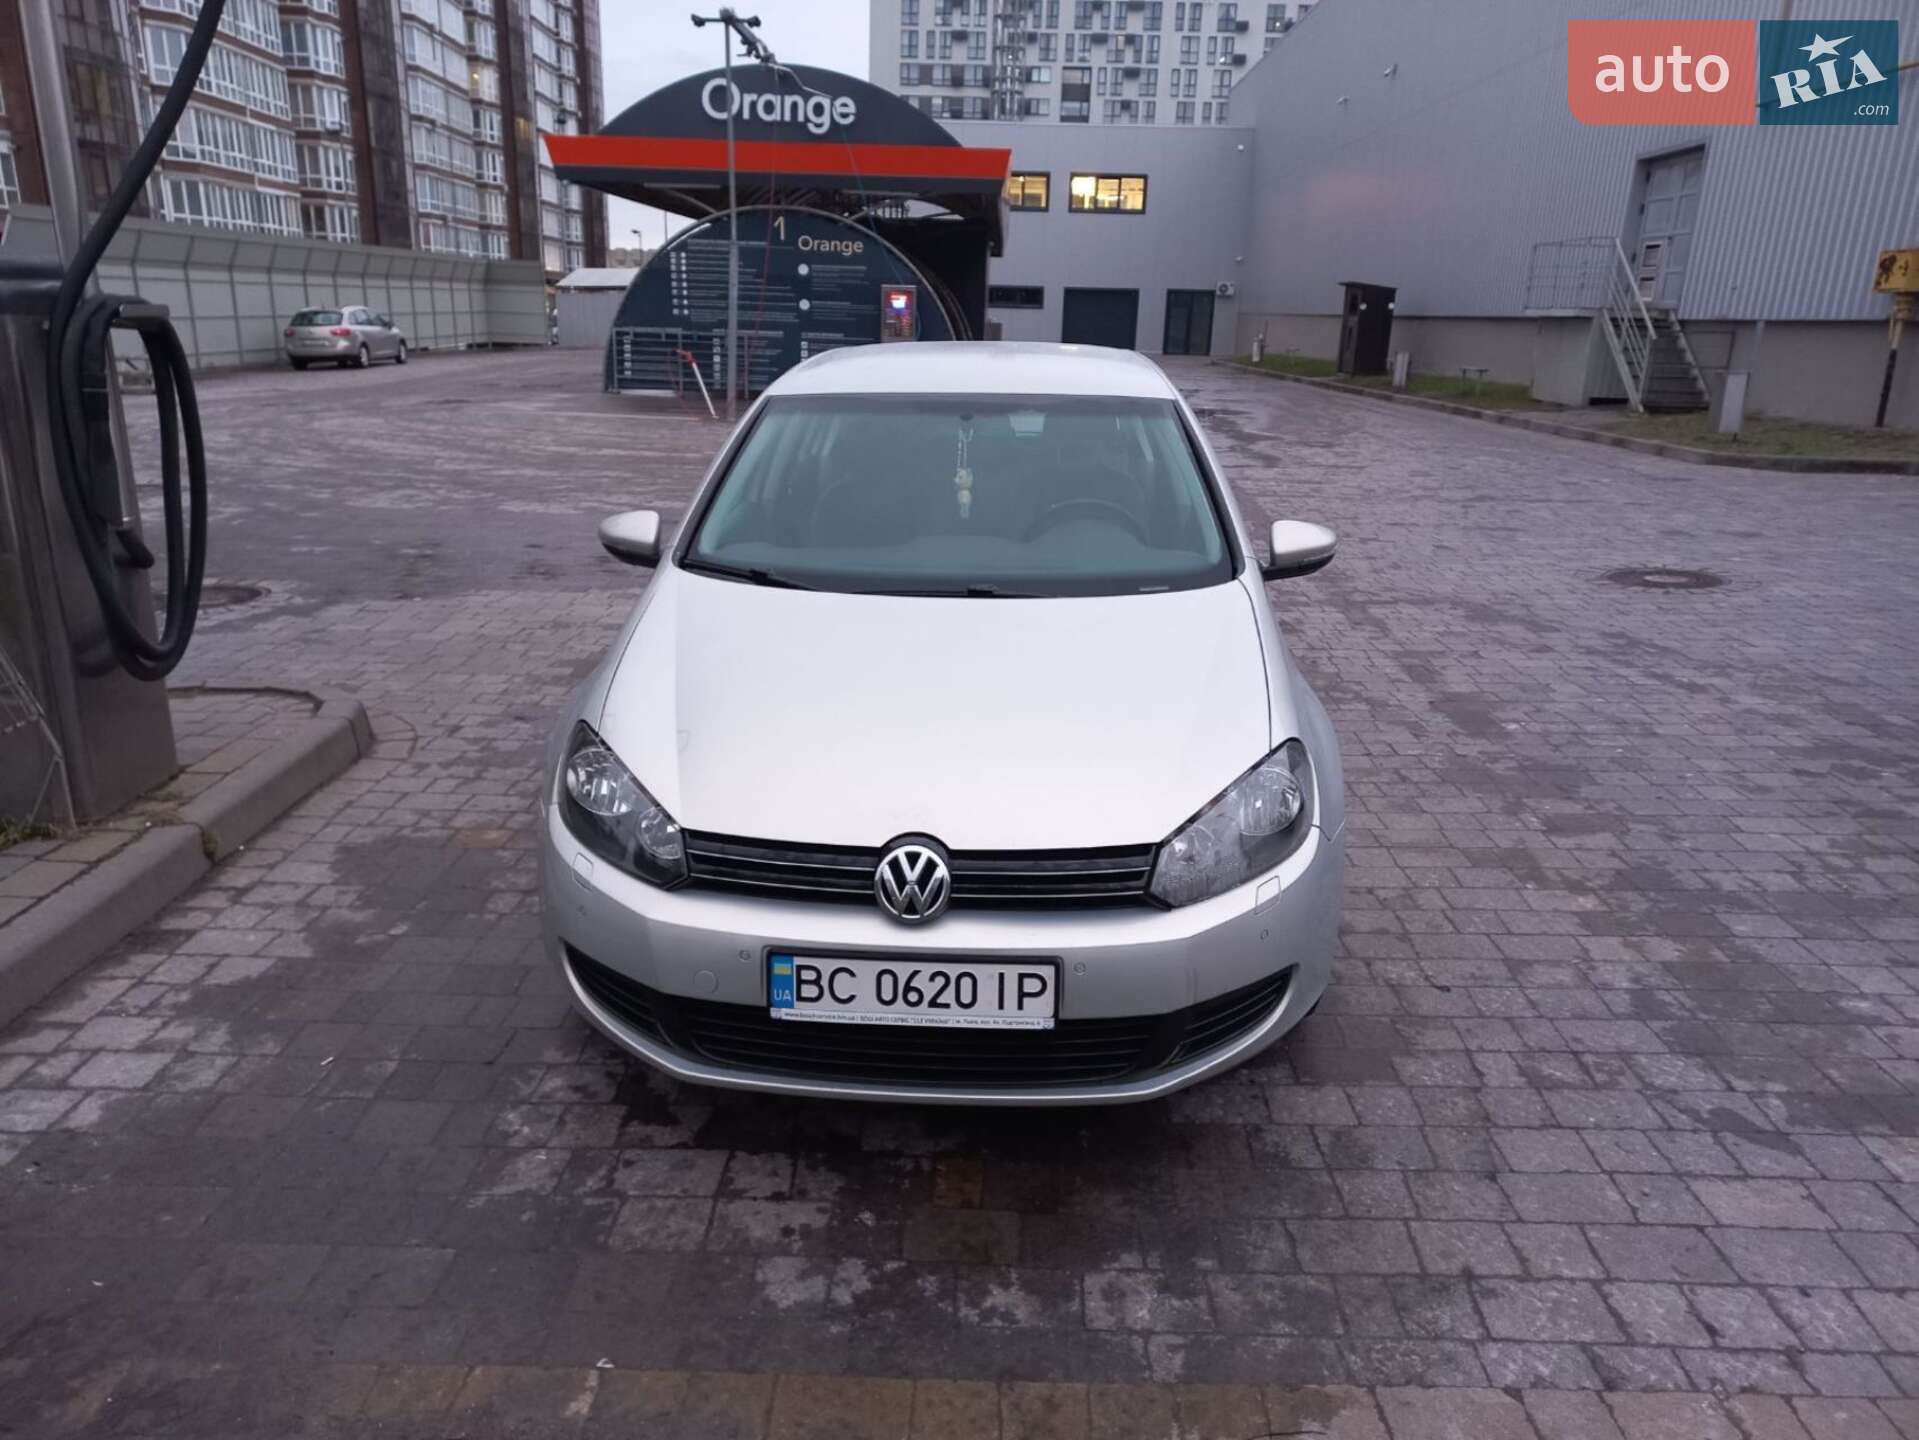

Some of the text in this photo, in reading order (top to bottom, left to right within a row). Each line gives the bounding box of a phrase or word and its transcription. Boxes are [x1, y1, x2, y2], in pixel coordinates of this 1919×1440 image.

[701, 77, 857, 135] Orange
[773, 216, 785, 241] 1
[798, 235, 864, 254] Orange
[878, 845, 946, 919] VW
[773, 988, 792, 1002] UA
[795, 964, 1048, 1011] BC 0620 IP
